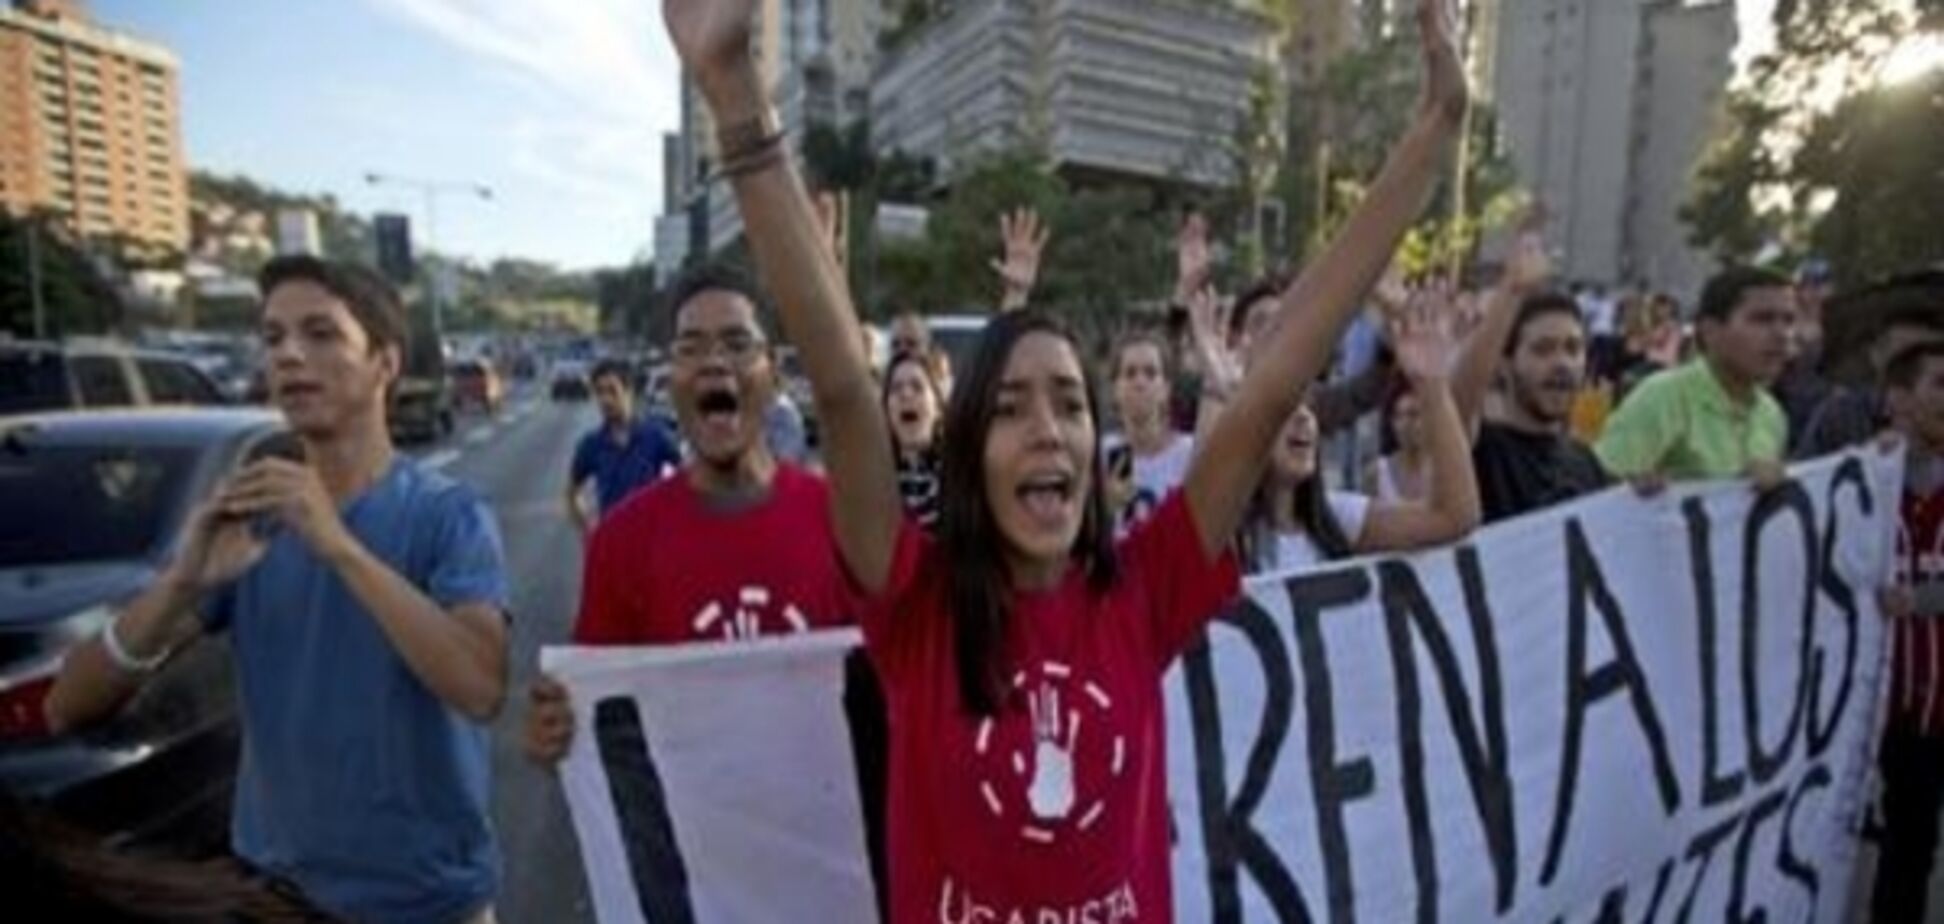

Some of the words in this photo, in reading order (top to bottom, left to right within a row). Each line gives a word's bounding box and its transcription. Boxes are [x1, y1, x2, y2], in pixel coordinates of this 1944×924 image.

[1163, 546, 1516, 924] REN
[1539, 517, 1681, 887] A
[1682, 456, 1873, 806] LOS
